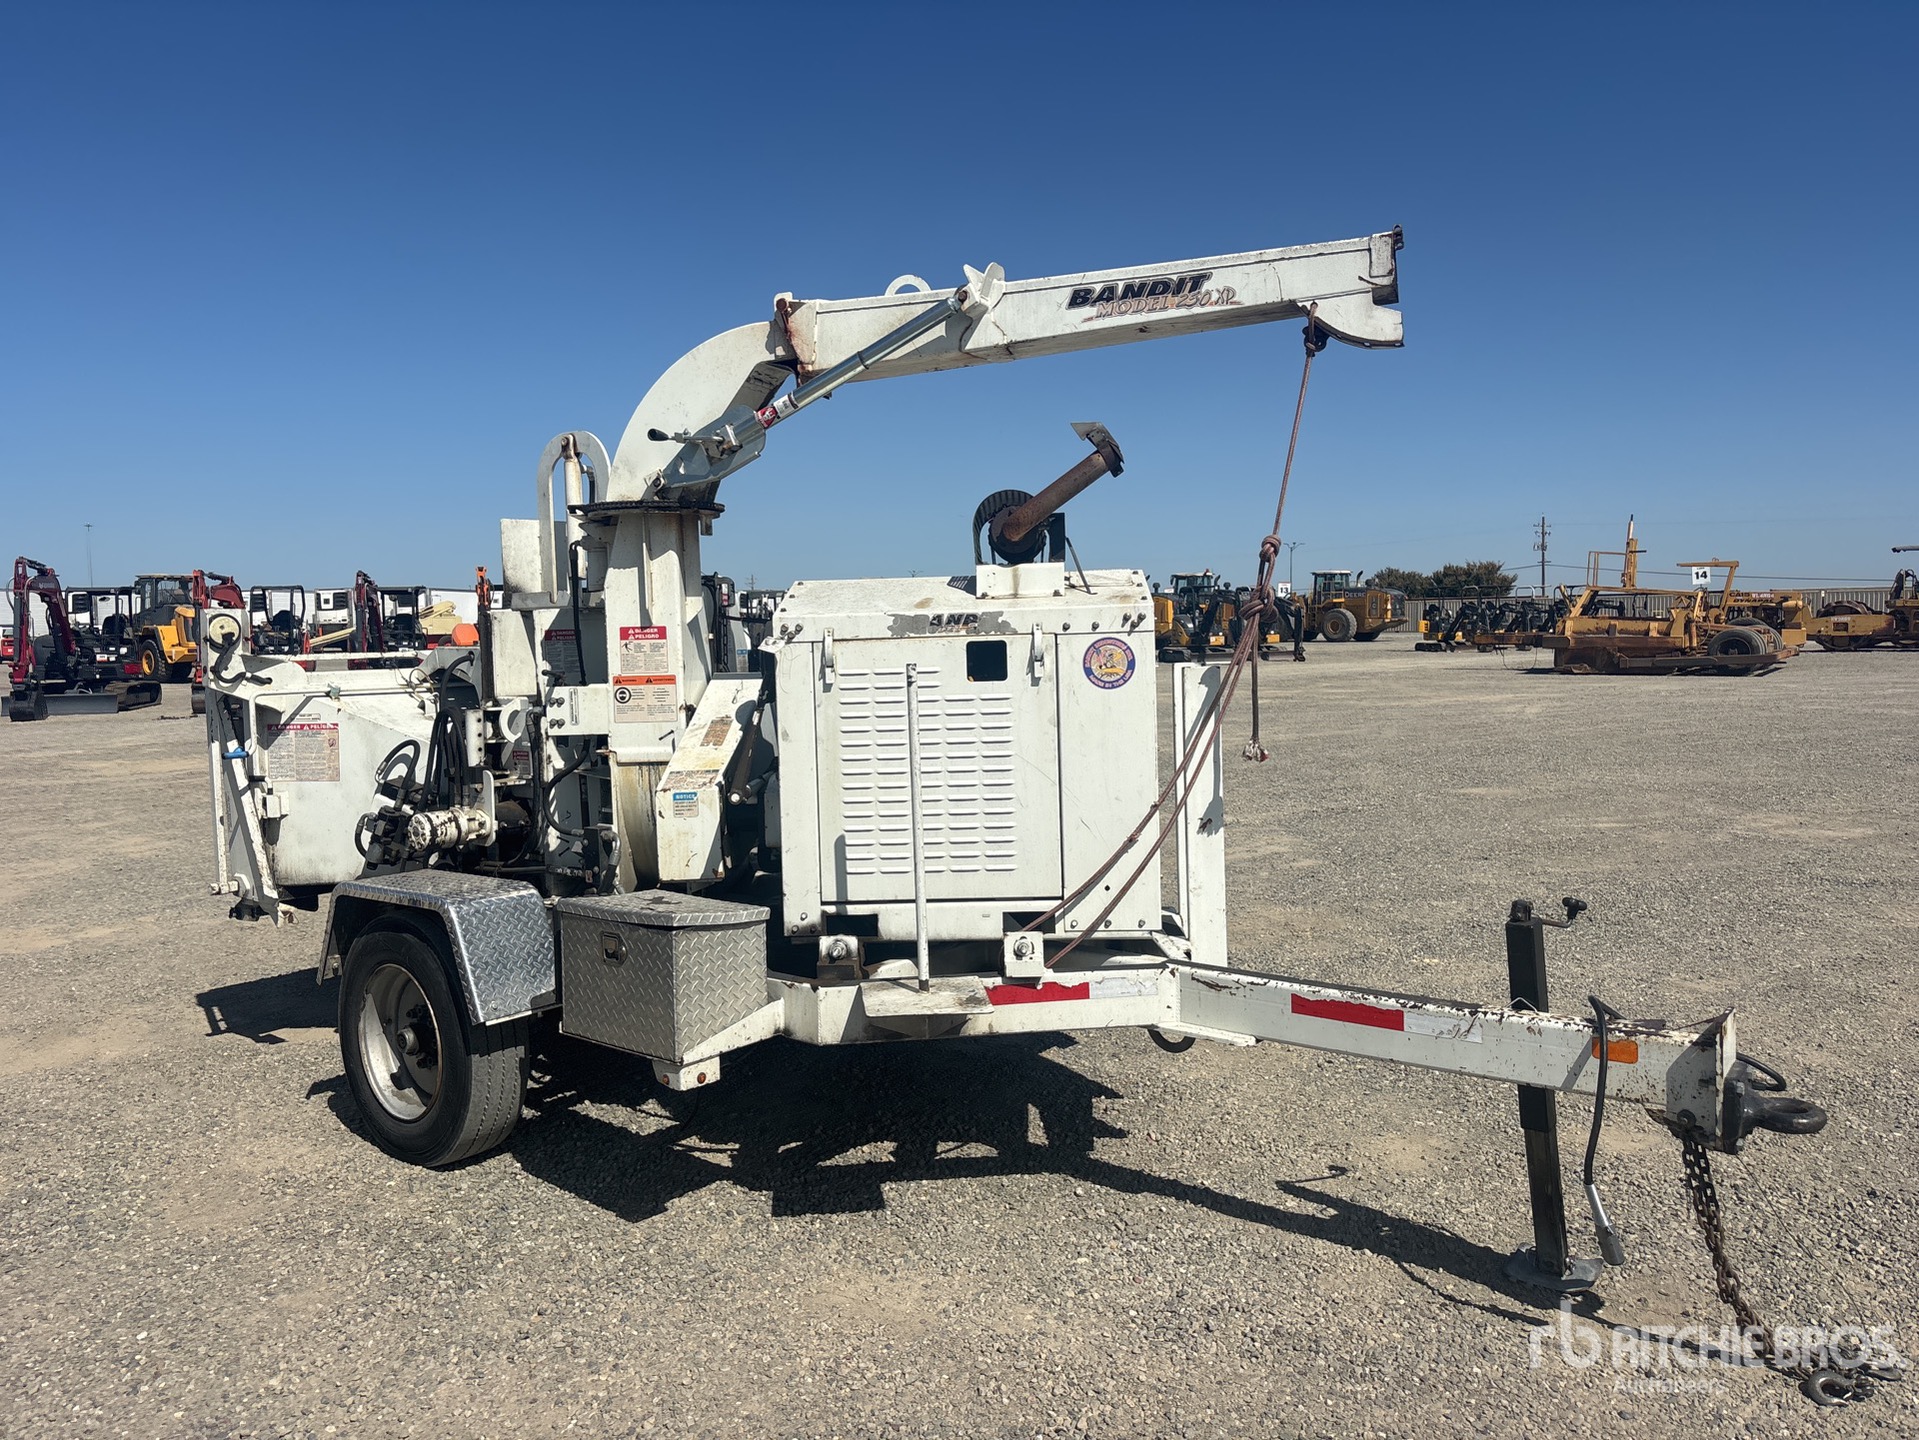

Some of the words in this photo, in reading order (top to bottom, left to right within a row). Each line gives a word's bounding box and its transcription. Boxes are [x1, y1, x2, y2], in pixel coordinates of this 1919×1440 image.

[1067, 272, 1212, 310] BANDIT
[1095, 294, 1171, 318] MODEL
[1175, 290, 1212, 308] 250
[1216, 286, 1237, 305] XP
[1694, 571, 1708, 580] 14
